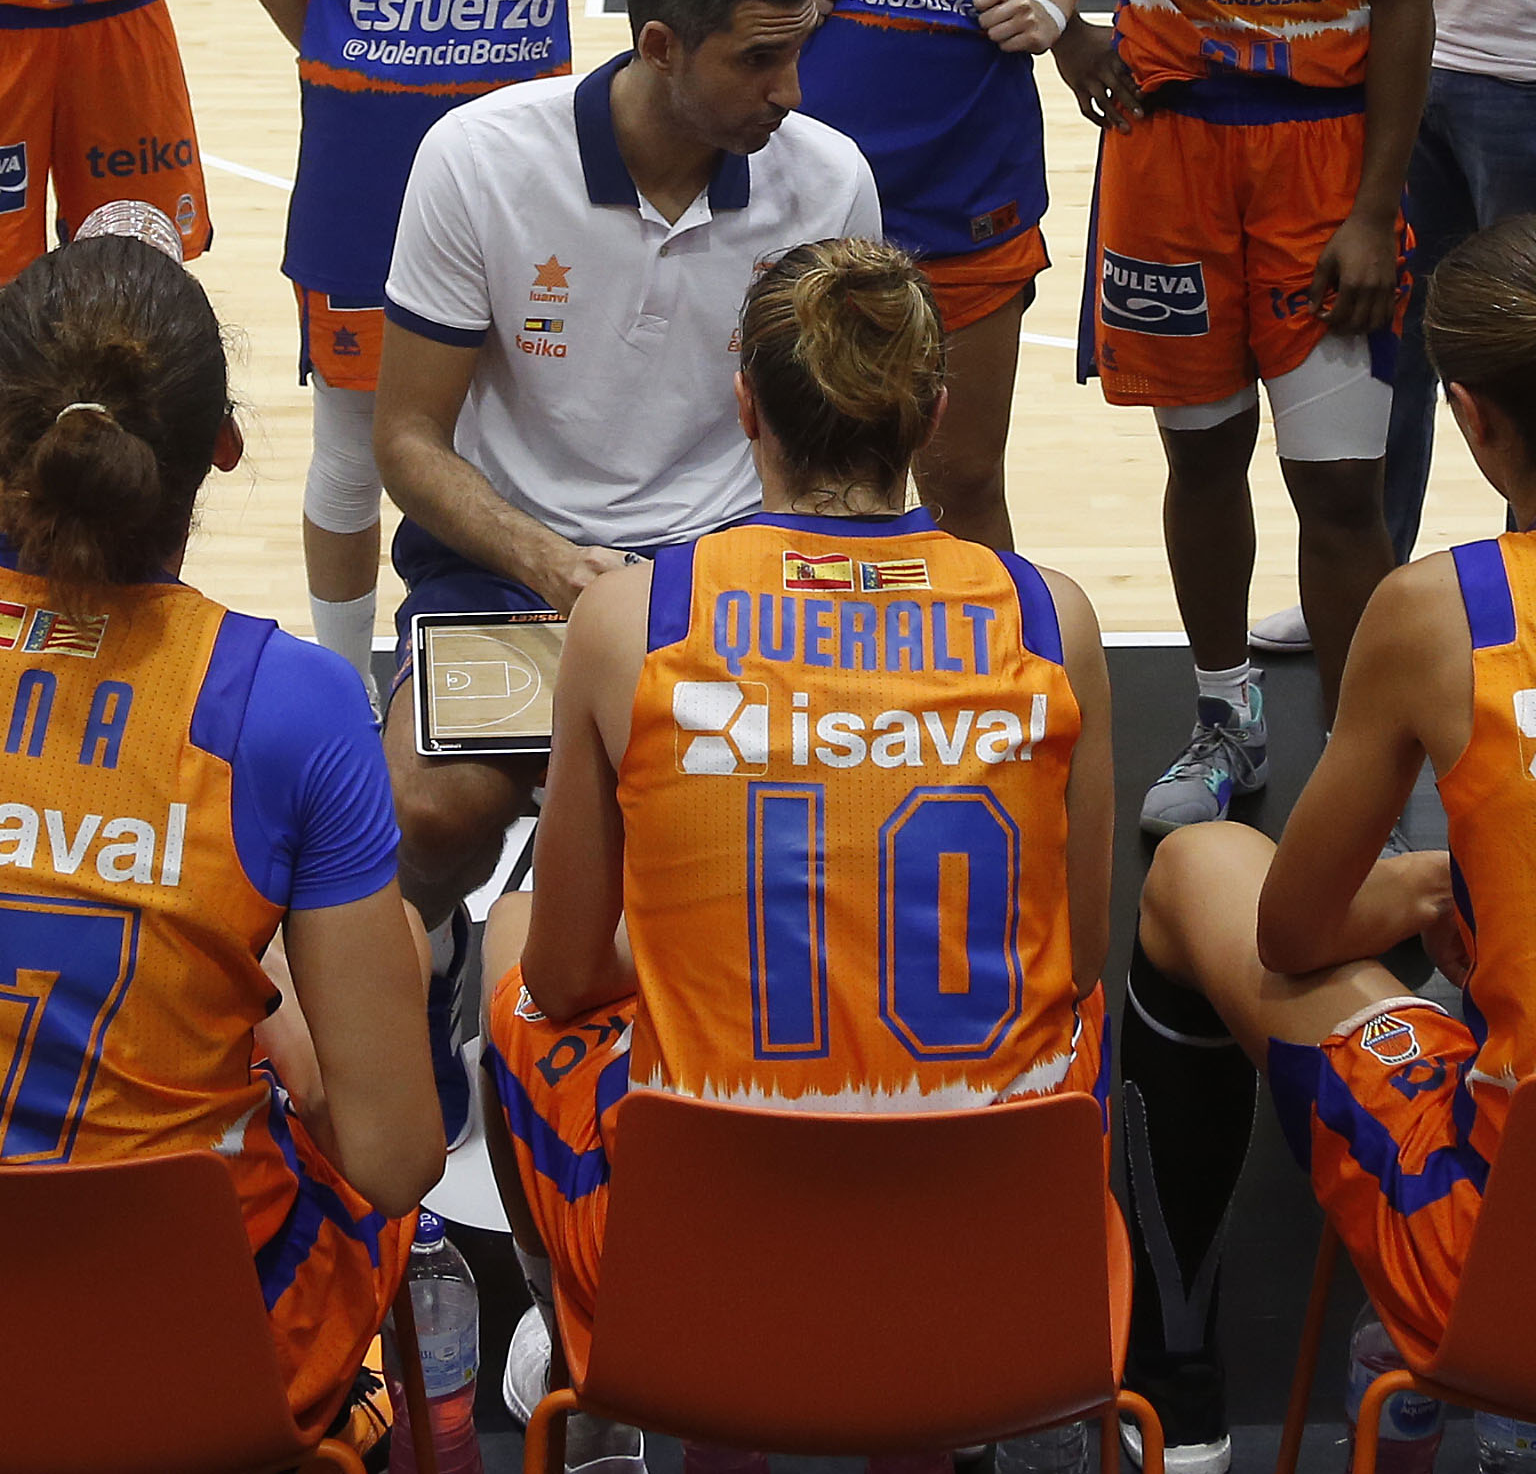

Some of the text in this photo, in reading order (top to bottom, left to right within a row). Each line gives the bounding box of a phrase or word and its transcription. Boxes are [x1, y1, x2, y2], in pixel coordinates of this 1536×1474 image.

[341, 35, 555, 67] @ValenciaBasket
[85, 135, 195, 180] teika
[529, 288, 570, 304] luanvi
[1102, 259, 1198, 296] PULEVA
[515, 333, 569, 360] teika
[713, 589, 996, 676] QUERALT
[791, 692, 1049, 769] isaval
[746, 781, 1023, 1063] 10
